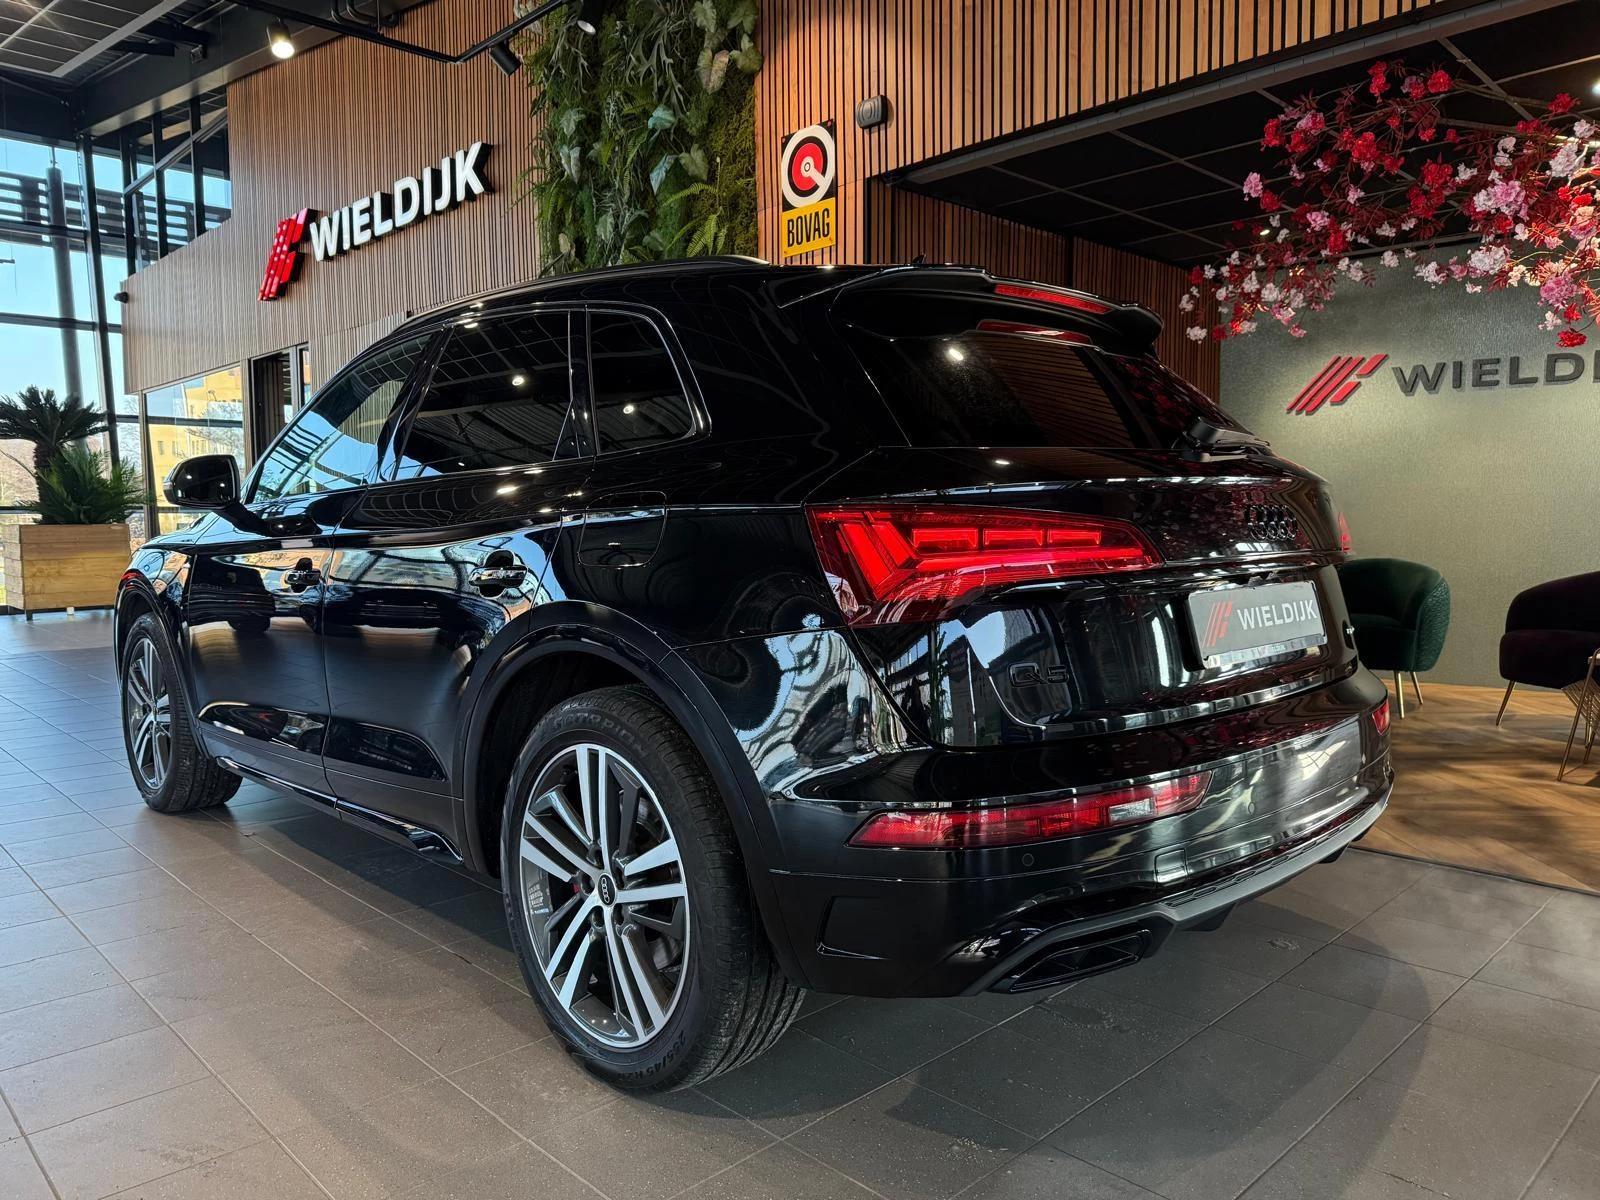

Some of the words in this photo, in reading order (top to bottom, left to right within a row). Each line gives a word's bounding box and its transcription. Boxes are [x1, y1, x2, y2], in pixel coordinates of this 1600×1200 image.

[309, 141, 485, 262] WIELDIJK
[787, 208, 830, 248] BOVAG
[1237, 600, 1317, 630] WIELDIJK
[1008, 663, 1069, 687] Q5
